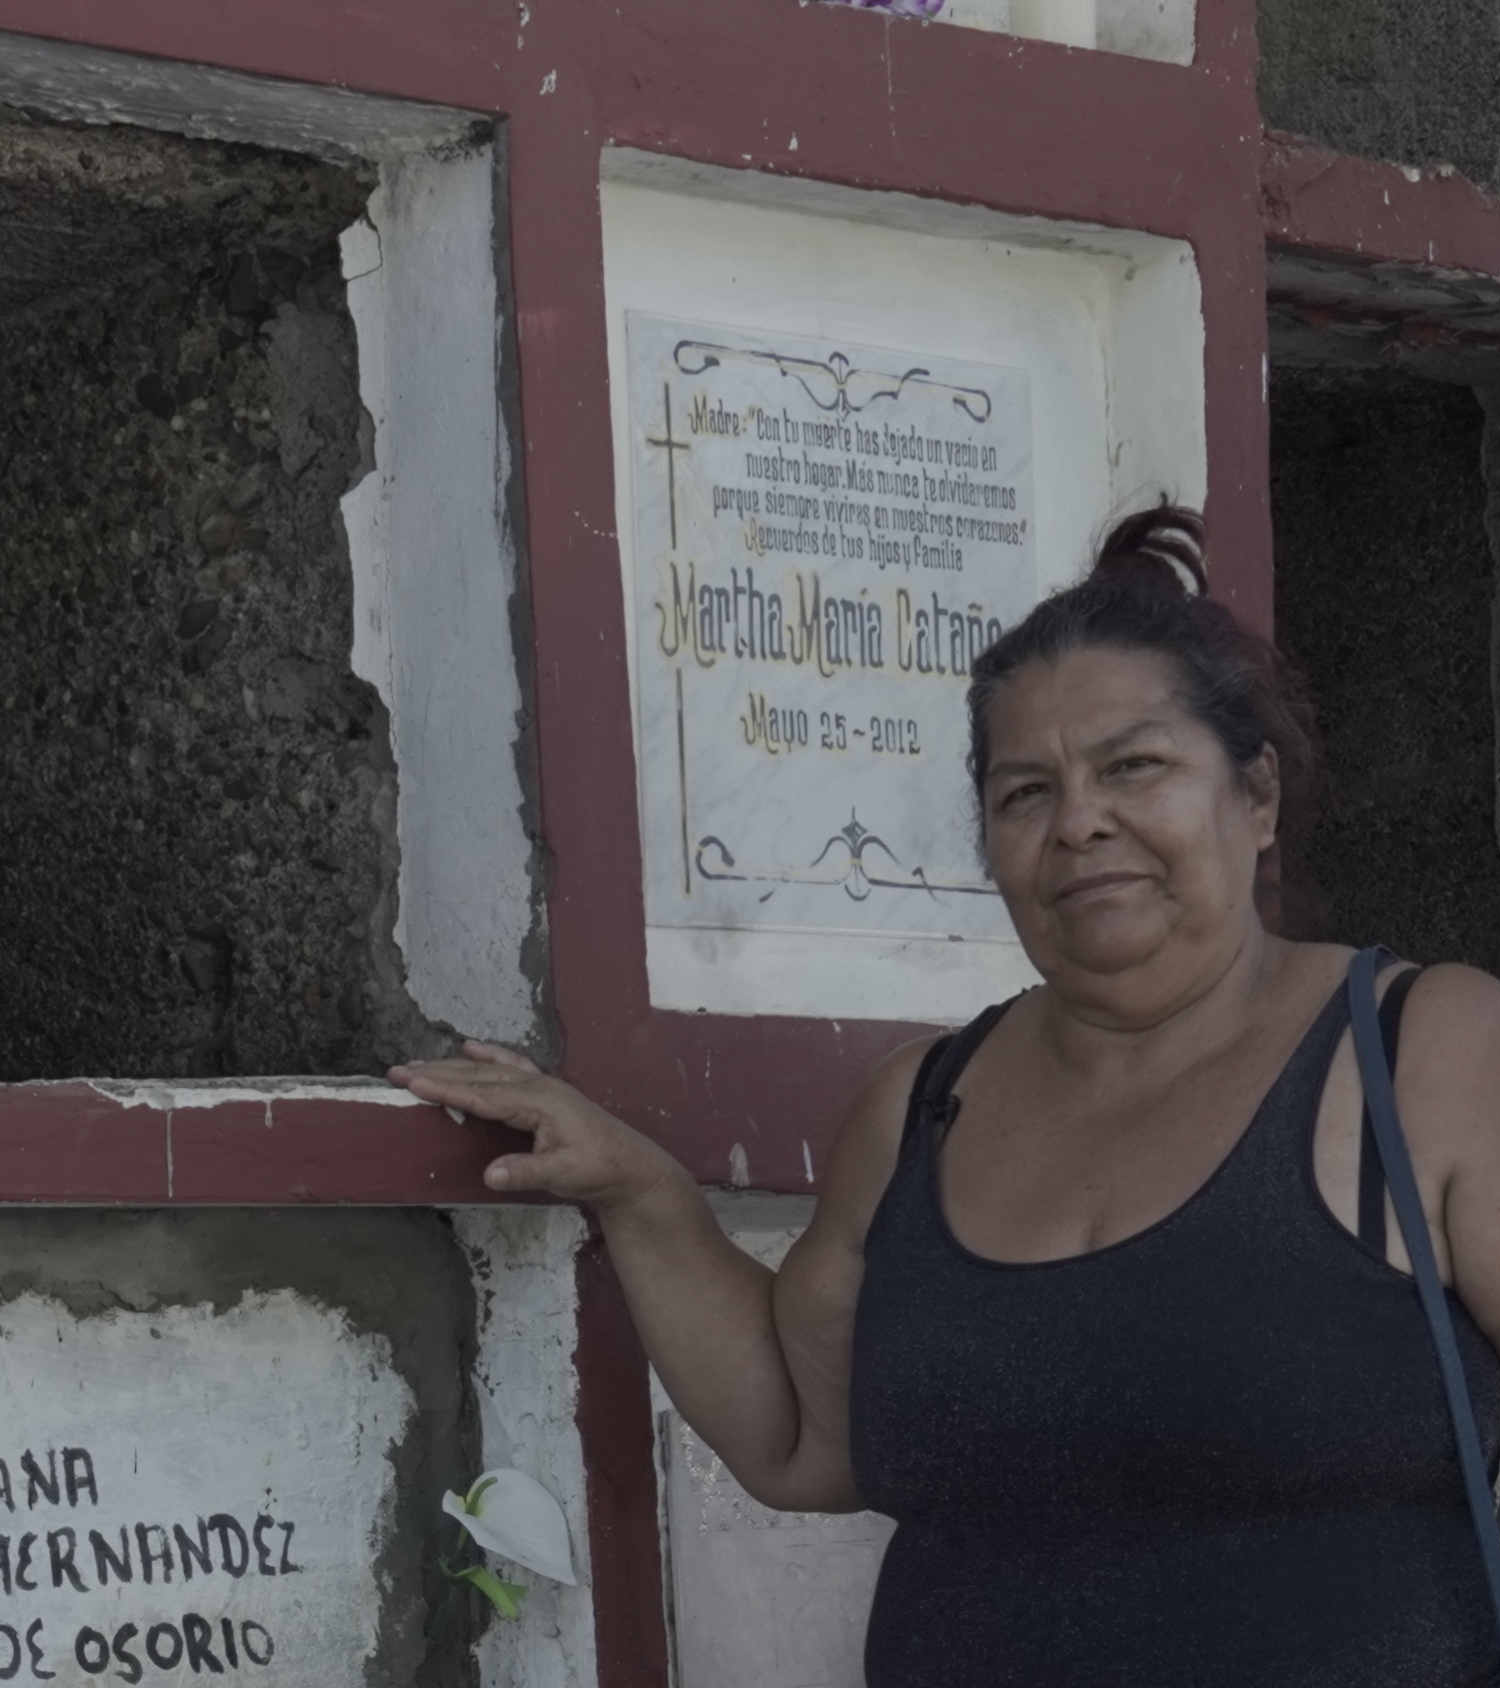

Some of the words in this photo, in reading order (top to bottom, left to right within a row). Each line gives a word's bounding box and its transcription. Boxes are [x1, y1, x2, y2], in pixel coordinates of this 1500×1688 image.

[783, 408, 800, 446] tu
[802, 418, 852, 453] muerte
[855, 421, 879, 457] has
[882, 423, 925, 466] dejado
[927, 437, 944, 465] un
[981, 444, 998, 472] en
[745, 446, 801, 484] nuestro
[846, 458, 875, 495] Más
[877, 470, 920, 500] nunca
[923, 468, 938, 503] te
[938, 469, 1017, 511] olvidaremos
[712, 484, 760, 521] porque
[765, 487, 821, 525] siempre
[874, 505, 890, 531] en
[892, 502, 954, 539] nuestros
[744, 518, 819, 558] Recuerdos
[821, 524, 838, 557] de
[839, 525, 864, 560] tus
[868, 529, 901, 571] hijos
[901, 546, 912, 573] y
[655, 561, 787, 670] Martha
[786, 572, 885, 679] María
[740, 692, 809, 756] Mayo
[75, 1612, 276, 1685] OSORIO
